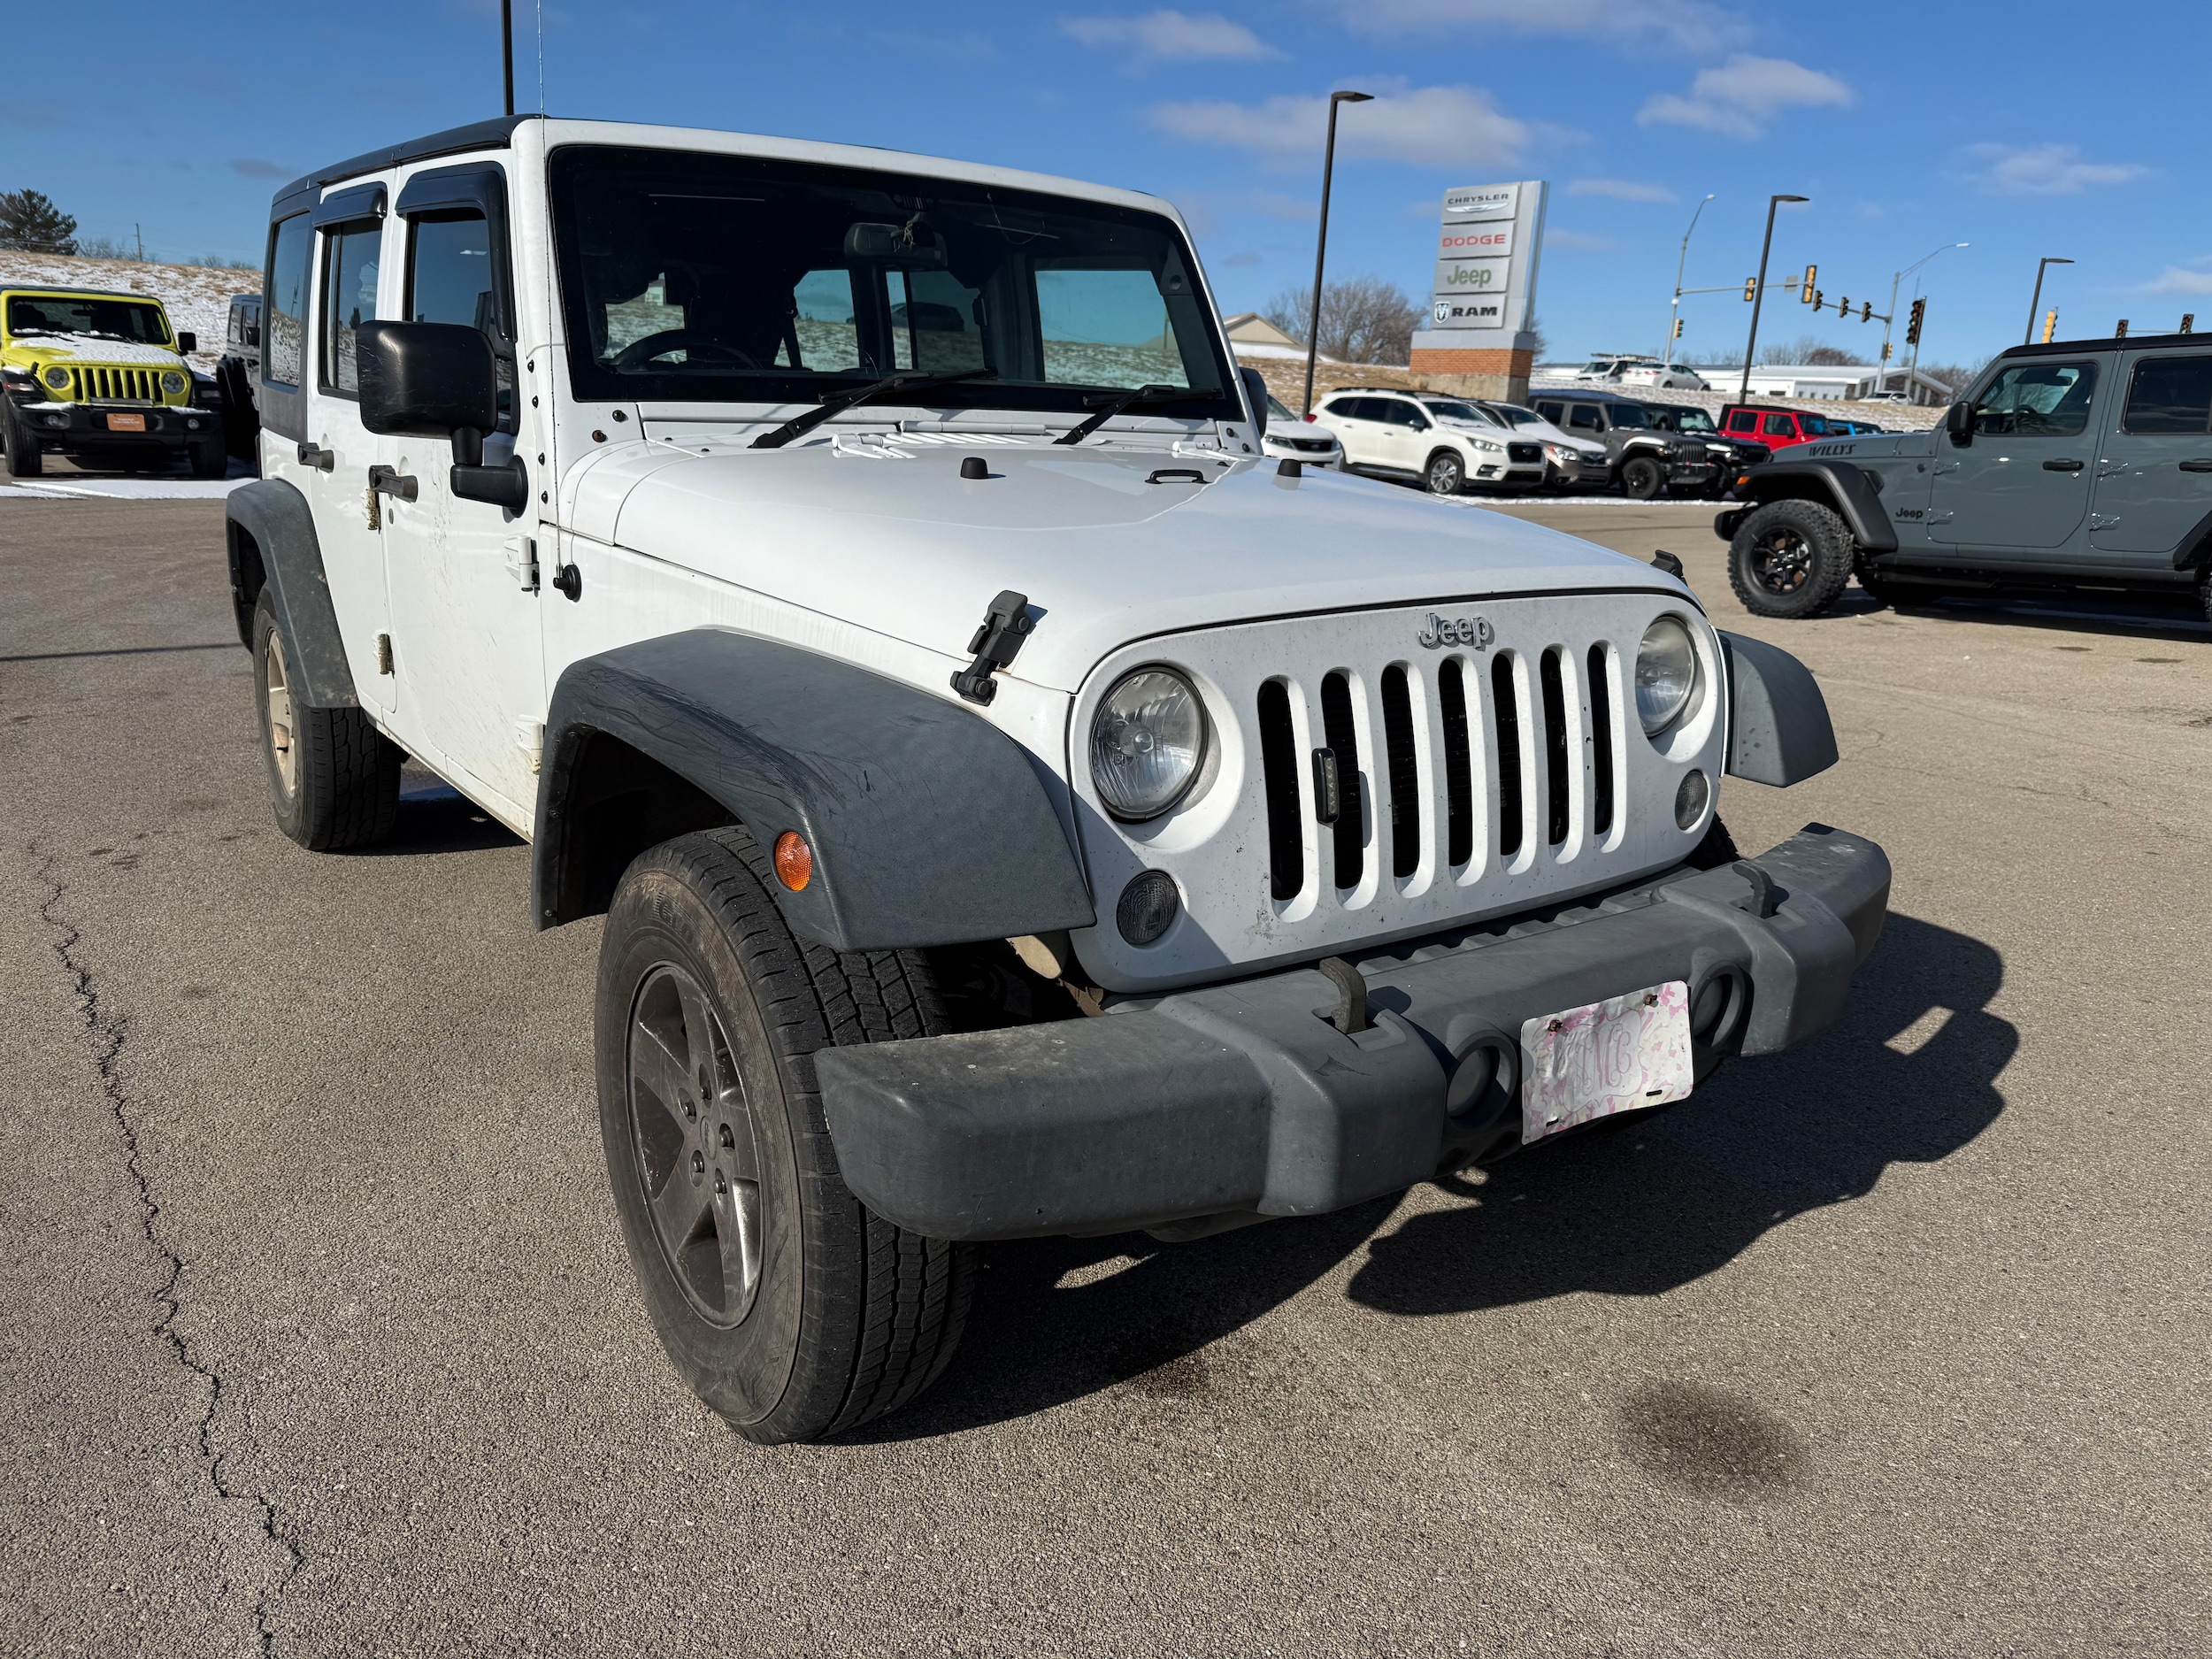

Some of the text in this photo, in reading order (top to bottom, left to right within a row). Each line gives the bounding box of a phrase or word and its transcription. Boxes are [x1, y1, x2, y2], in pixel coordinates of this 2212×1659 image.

[1448, 193, 1509, 204] CHRYSLER
[1442, 234, 1506, 247] DODGE
[1447, 265, 1492, 288] Jeep
[1451, 306, 1497, 317] RAM
[1809, 444, 1855, 457] WILLYS
[1895, 507, 1923, 519] Jeep
[1417, 612, 1490, 649] Jeep
